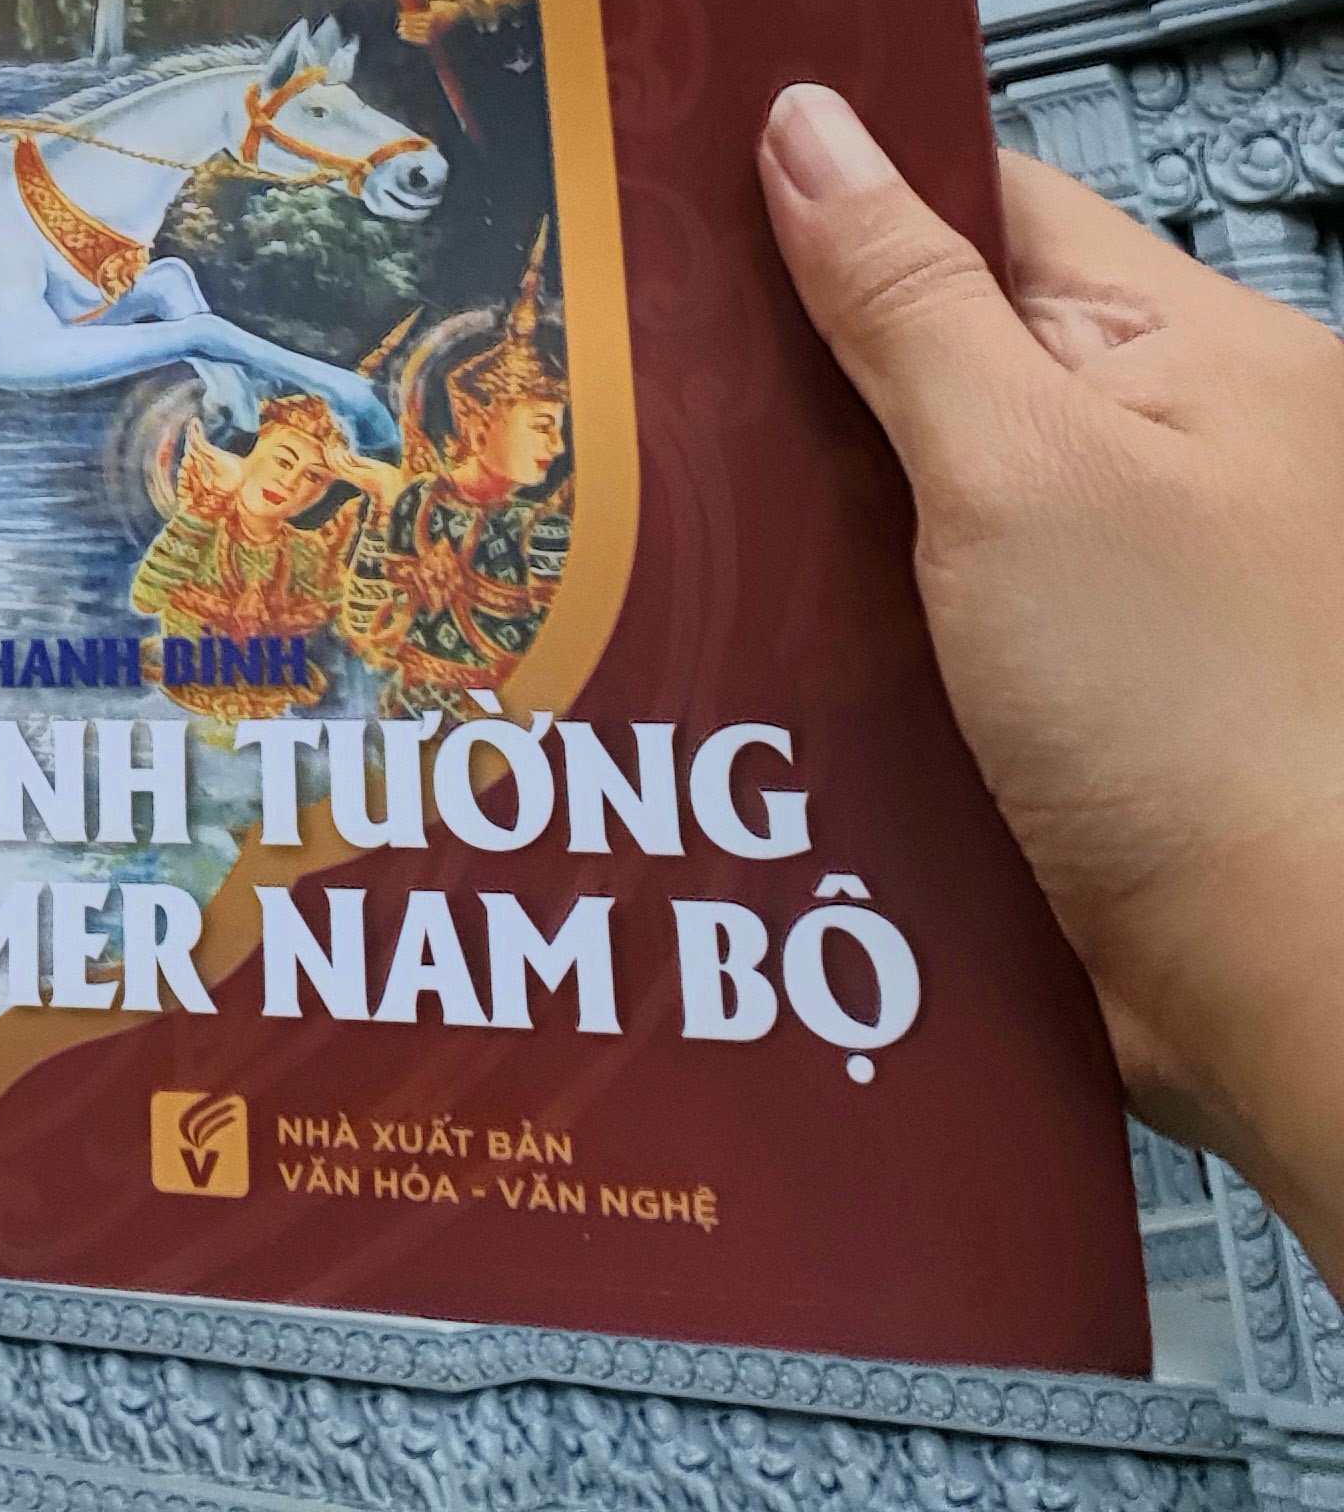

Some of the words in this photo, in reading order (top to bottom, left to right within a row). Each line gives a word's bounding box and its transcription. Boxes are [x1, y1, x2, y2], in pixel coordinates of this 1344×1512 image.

[162, 624, 306, 687] BÌNH
[234, 688, 813, 861] TƯỜNG
[253, 885, 624, 1036] NAM
[670, 873, 920, 1084] BỘ
[277, 1111, 360, 1151] NHÀ
[370, 1113, 474, 1159] XUẤT
[486, 1118, 573, 1166] BẢN
[277, 1155, 361, 1197] VĂN
[373, 1162, 460, 1205] HÓA
[496, 1171, 587, 1215] VĂN
[599, 1184, 720, 1234] NGHỆ
